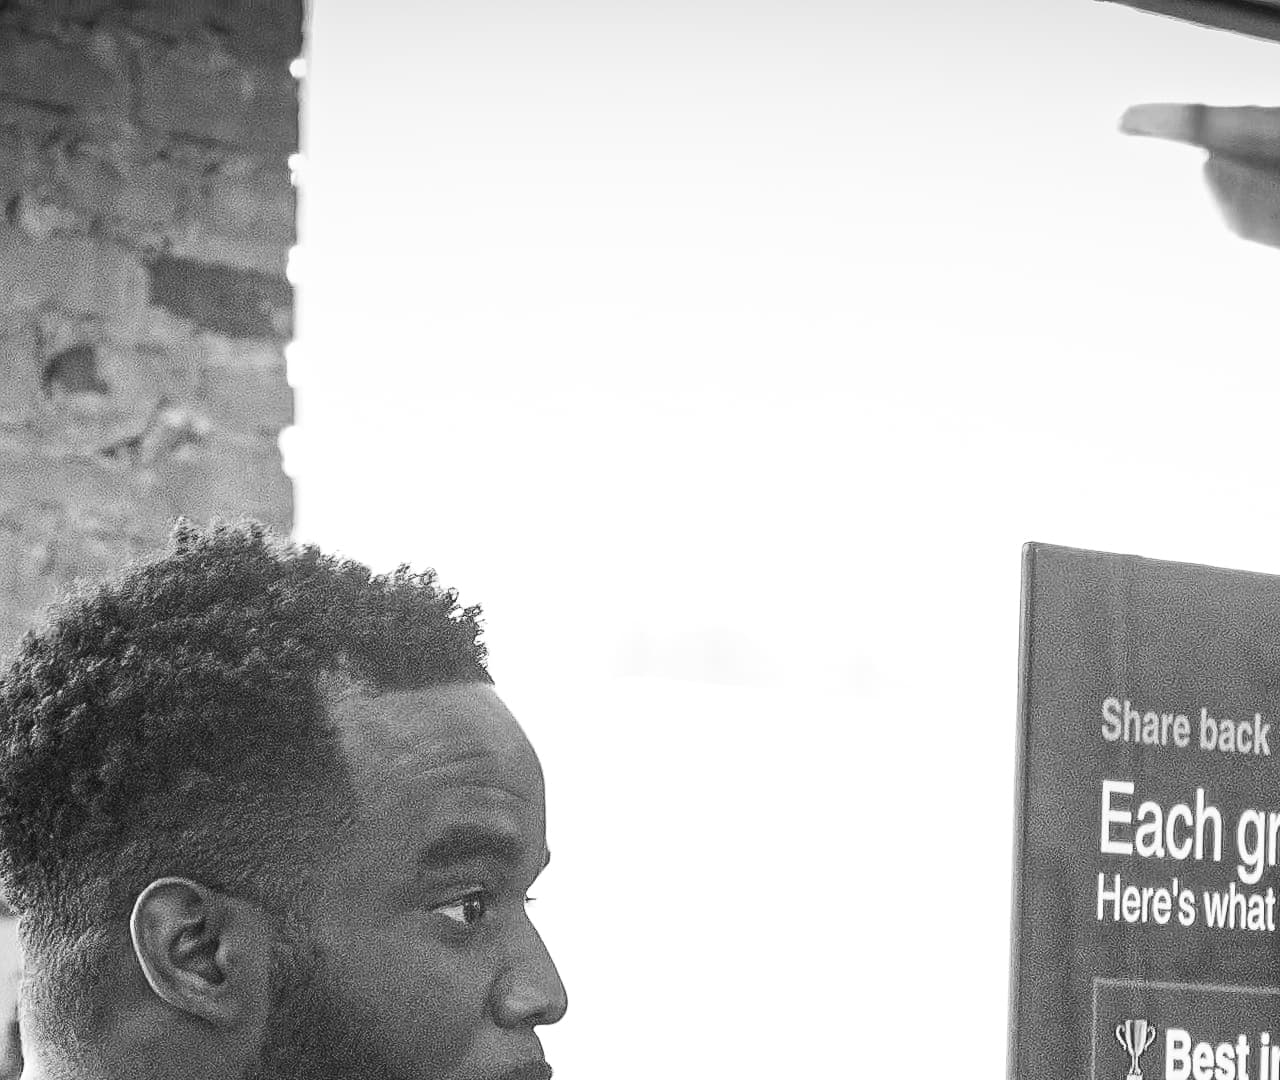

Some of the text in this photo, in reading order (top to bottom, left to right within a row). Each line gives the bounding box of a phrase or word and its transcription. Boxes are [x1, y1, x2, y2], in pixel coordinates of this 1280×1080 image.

[1101, 697, 1271, 756] Share back
[1100, 779, 1222, 862] Each
[1096, 872, 1196, 927] Here's
[1203, 877, 1276, 932] what
